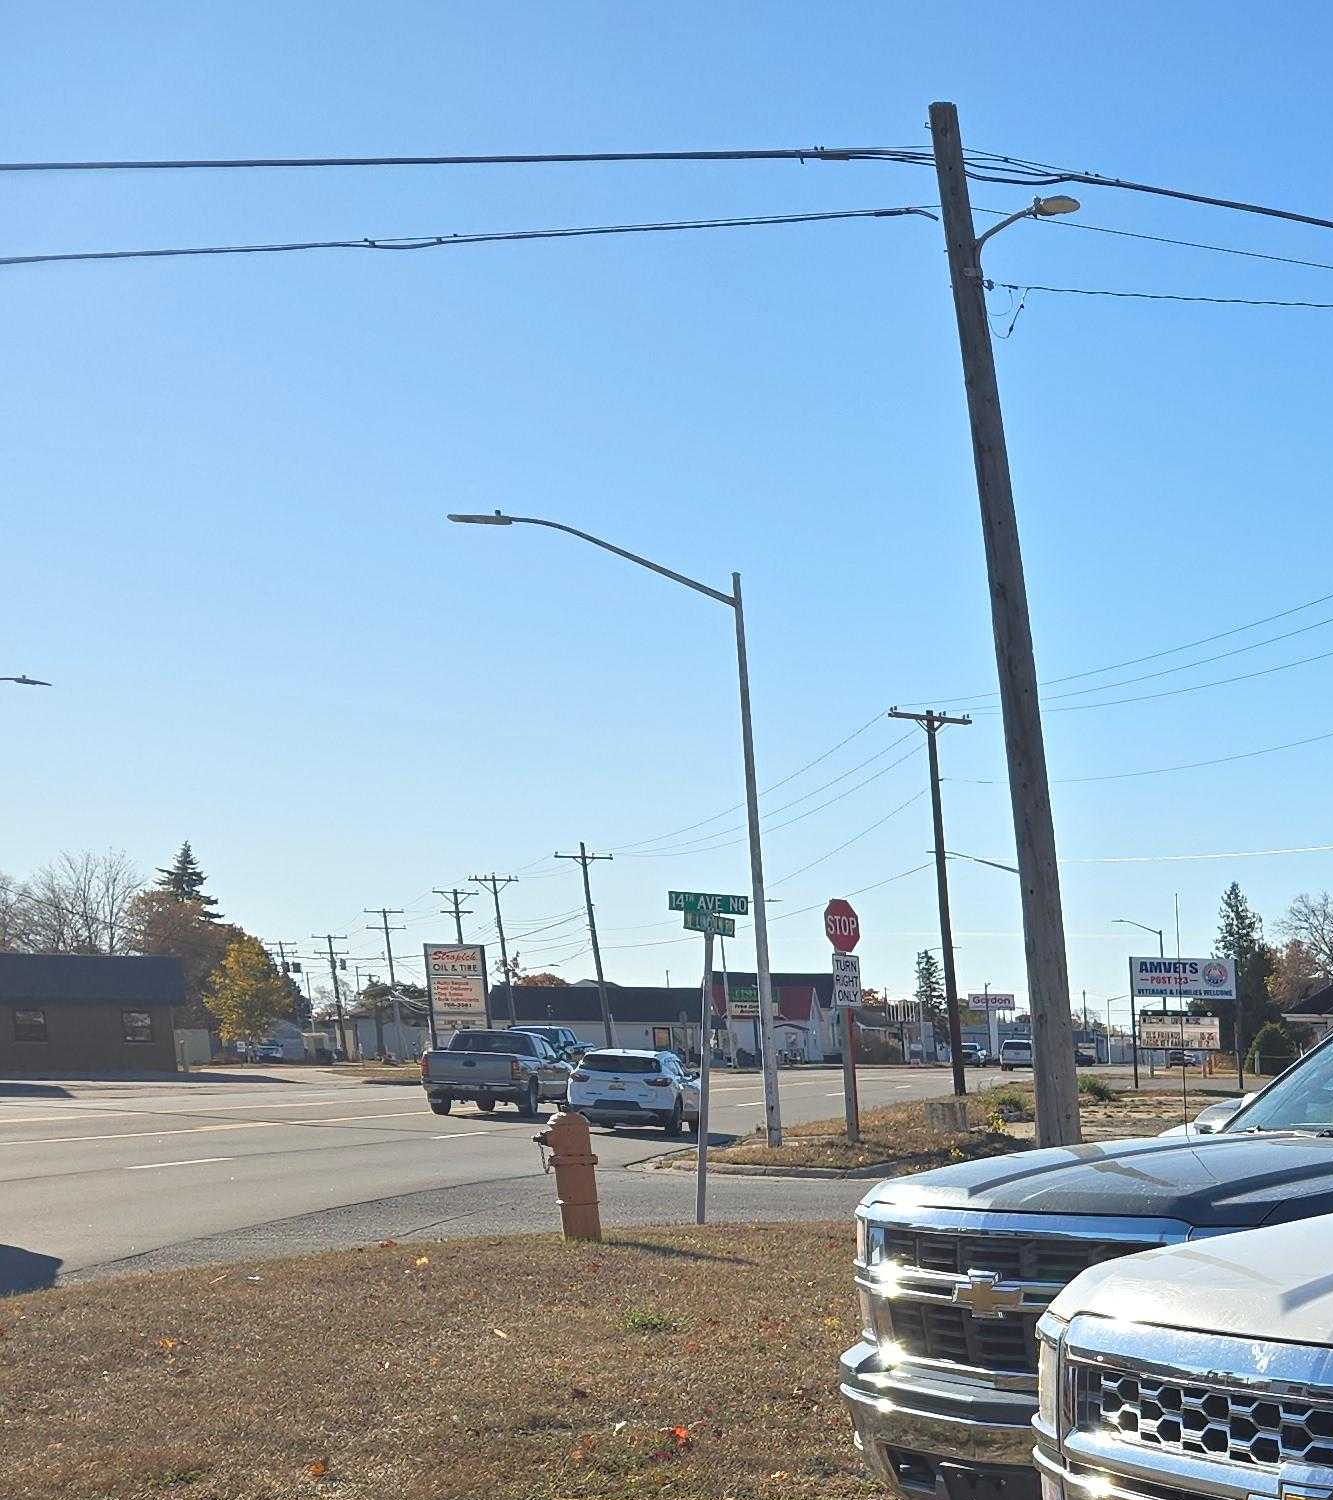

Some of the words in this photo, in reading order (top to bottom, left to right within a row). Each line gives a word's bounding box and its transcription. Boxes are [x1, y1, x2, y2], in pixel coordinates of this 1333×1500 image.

[697, 895, 723, 910] AVE
[729, 897, 747, 912] NO
[827, 915, 857, 936] STOP
[433, 963, 448, 971] OIL
[836, 959, 857, 973] TURN
[1139, 961, 1198, 974] AMVETS
[836, 974, 859, 987] RIGHT
[1150, 976, 1171, 984] POST
[1174, 976, 1189, 985] 123
[838, 989, 859, 1003] ONLY
[973, 996, 1011, 1004] Gordon
